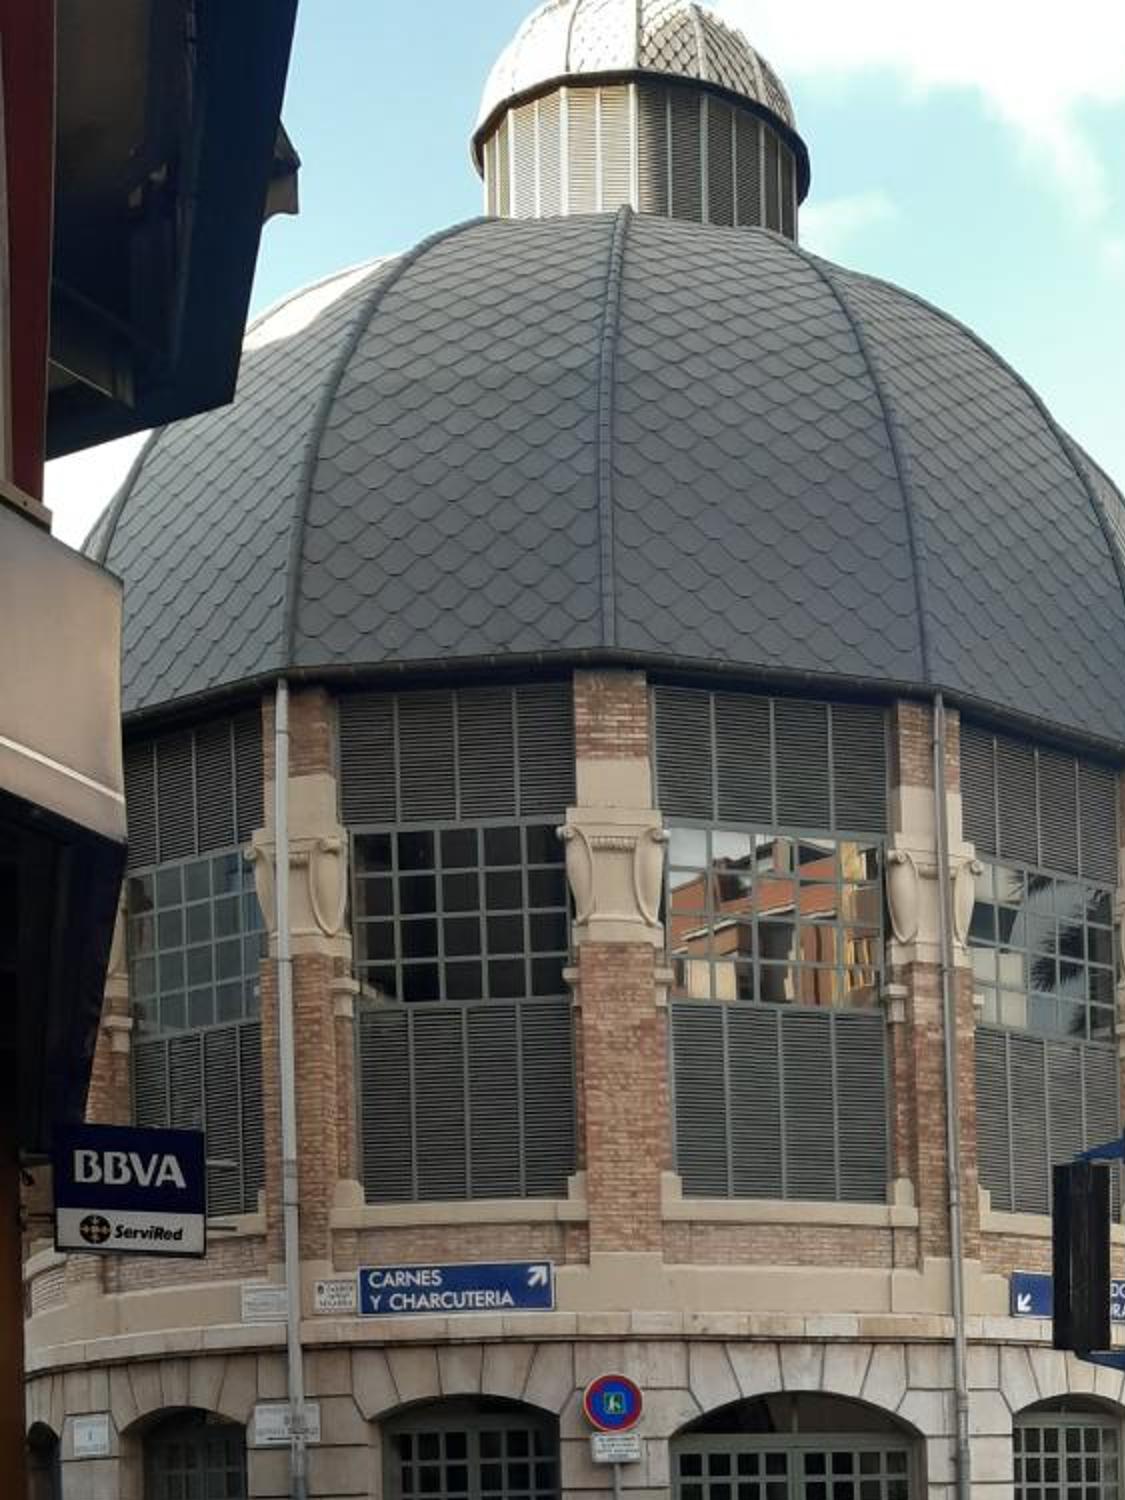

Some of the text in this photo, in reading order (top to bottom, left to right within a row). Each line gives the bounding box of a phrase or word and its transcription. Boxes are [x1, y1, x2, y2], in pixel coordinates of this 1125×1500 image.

[74, 1149, 187, 1189] BBVA
[114, 1225, 184, 1241] ServiRed
[368, 1269, 443, 1288] CARNES
[370, 1290, 515, 1311] Y CHARCUTERIA
